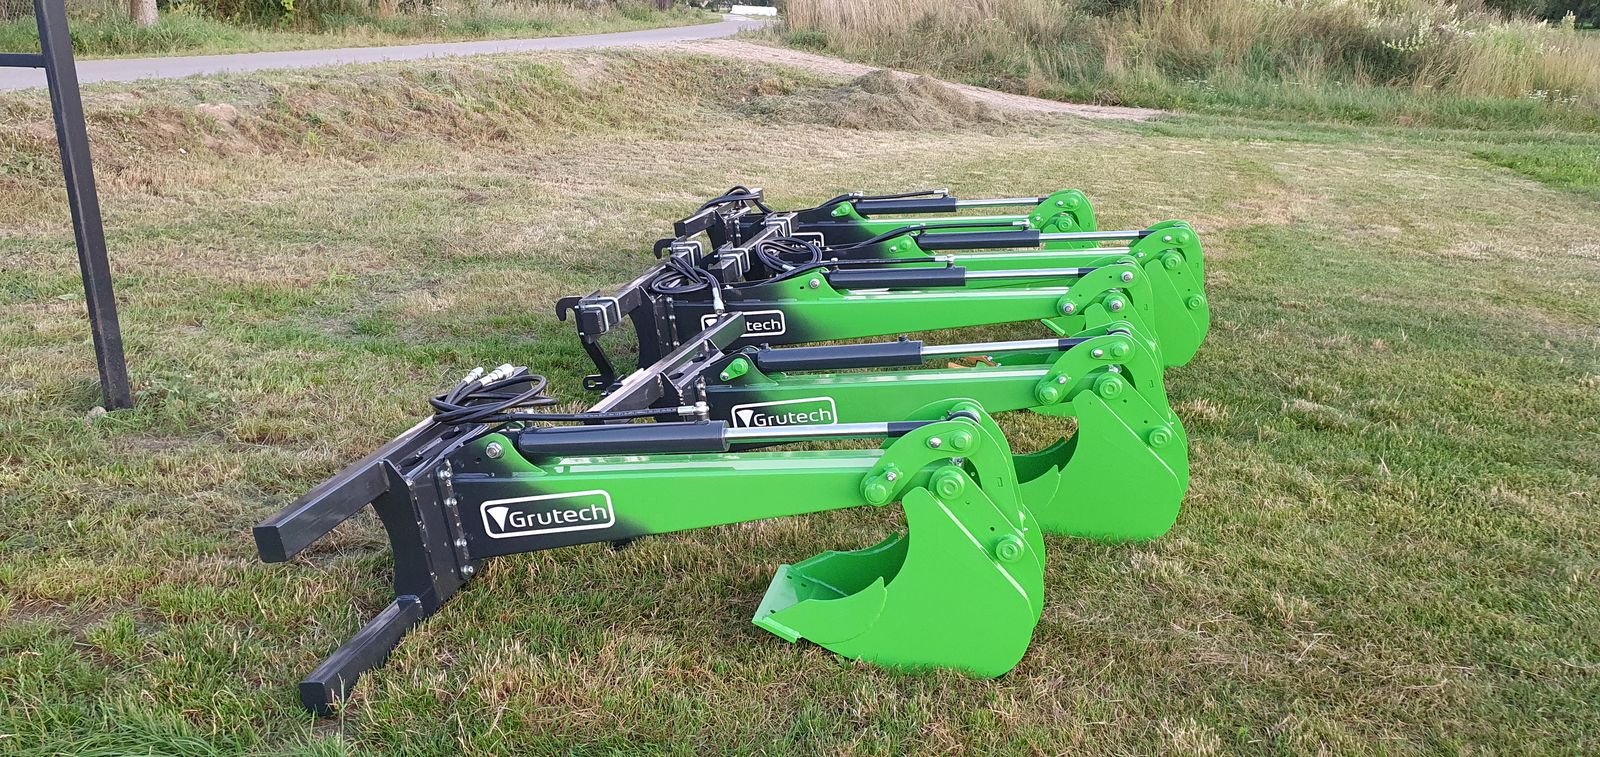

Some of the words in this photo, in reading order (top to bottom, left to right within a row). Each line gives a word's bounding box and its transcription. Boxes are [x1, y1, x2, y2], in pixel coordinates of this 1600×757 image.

[746, 318, 781, 331] tech
[753, 408, 832, 427] Grutech
[509, 504, 607, 528] Grutech
